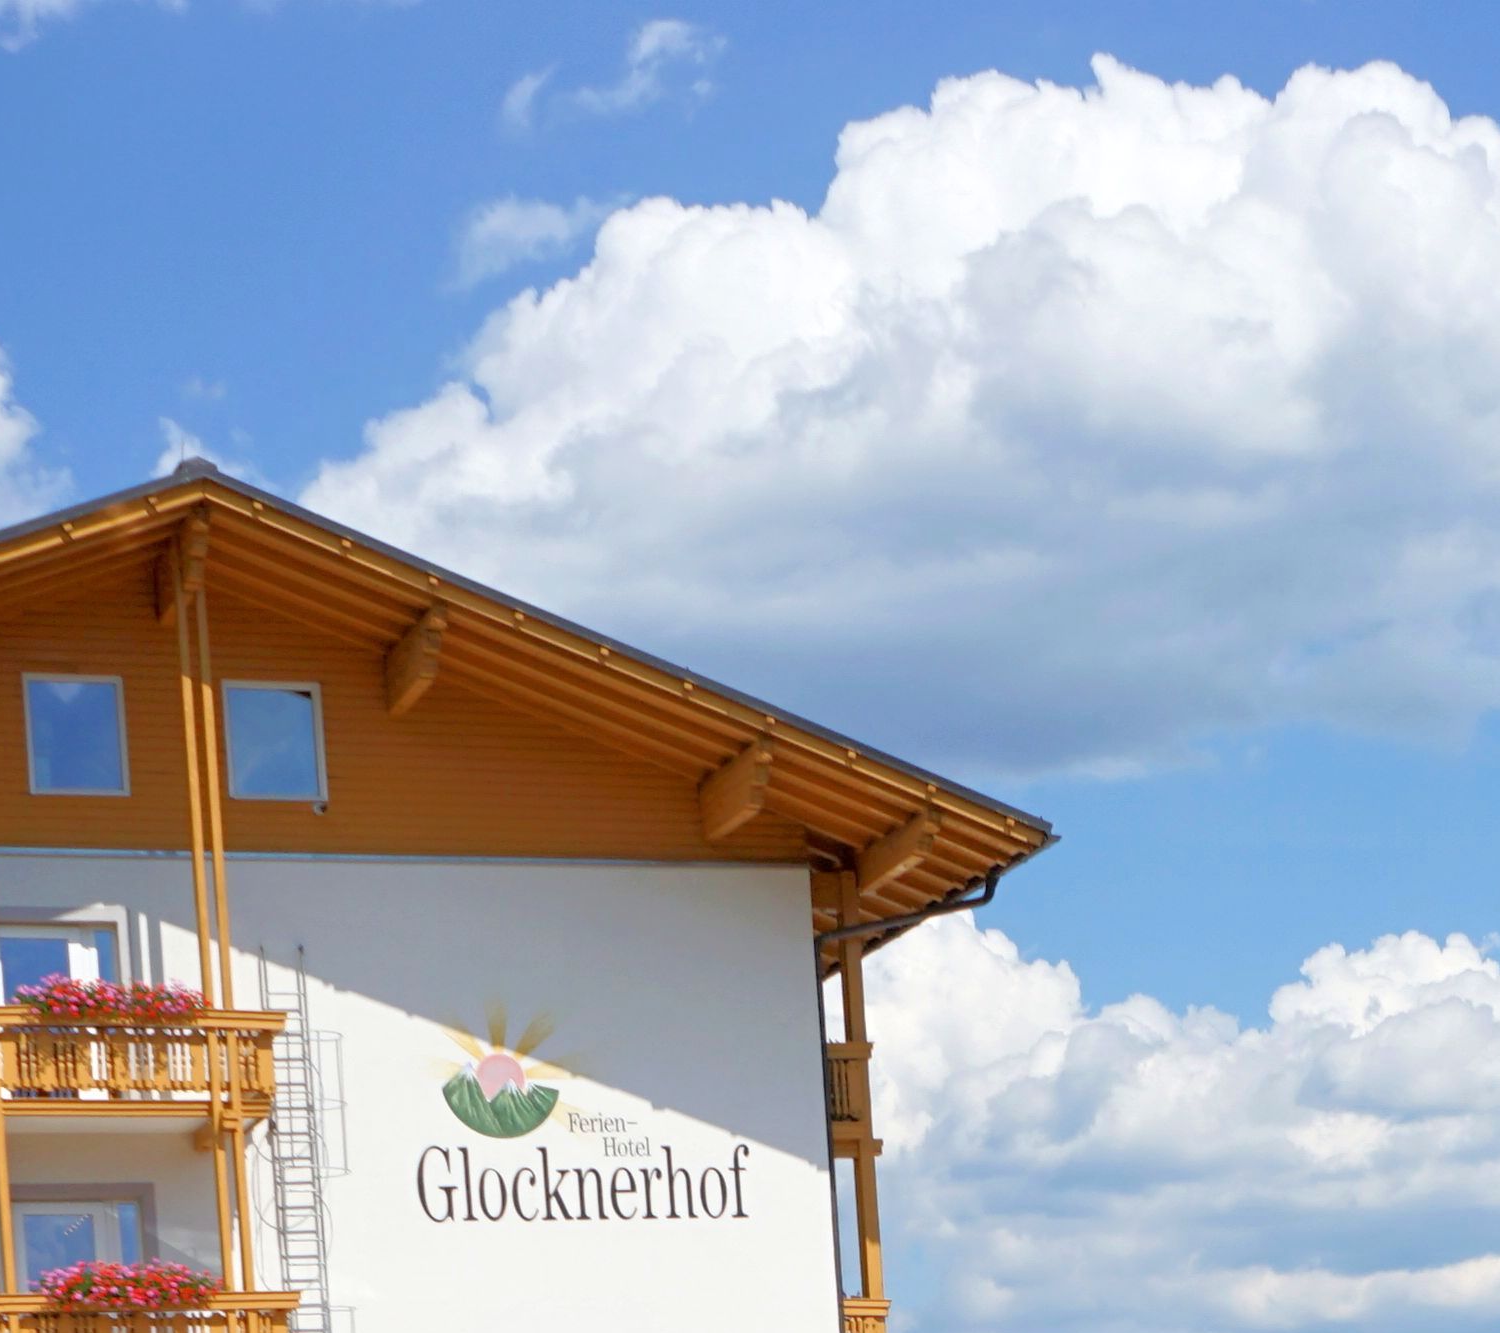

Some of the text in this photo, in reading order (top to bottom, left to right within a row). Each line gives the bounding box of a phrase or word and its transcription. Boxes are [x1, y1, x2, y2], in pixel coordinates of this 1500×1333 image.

[568, 1112, 638, 1133] Ferien-
[603, 1136, 651, 1157] Hotel
[416, 1144, 749, 1223] Glocknerhof
